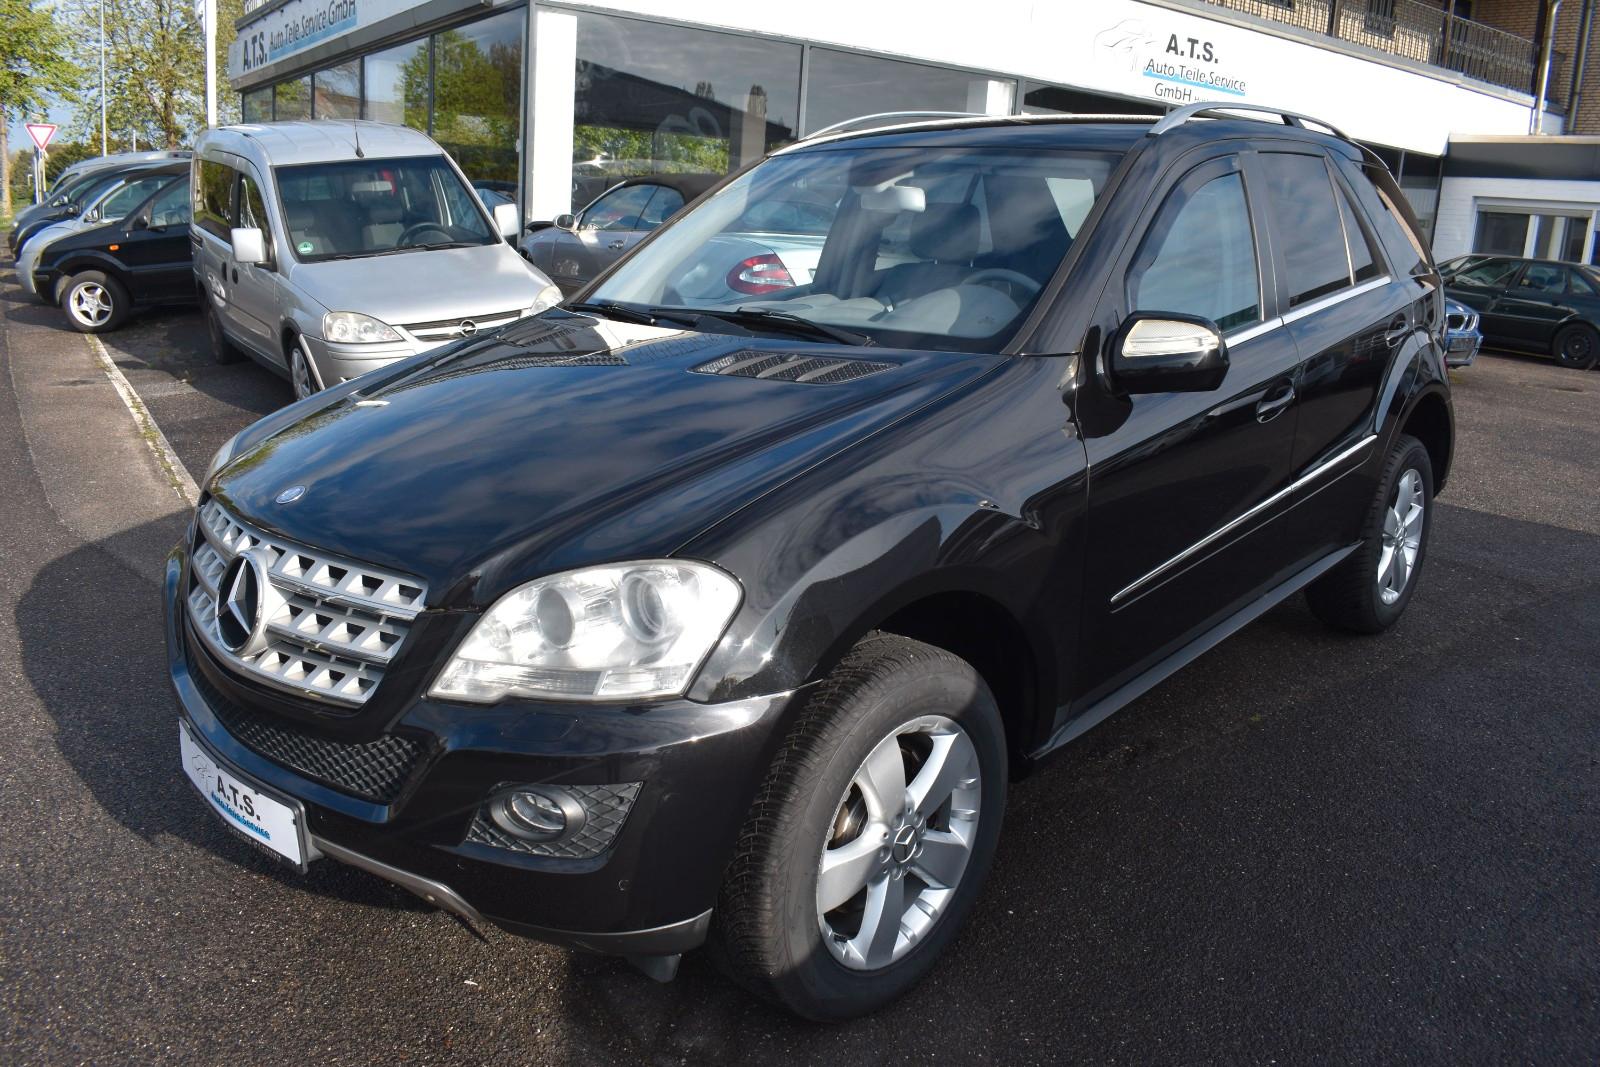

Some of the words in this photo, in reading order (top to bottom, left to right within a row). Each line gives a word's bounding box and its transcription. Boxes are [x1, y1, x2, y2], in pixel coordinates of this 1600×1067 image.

[243, 31, 267, 71] A.T.S.
[269, 31, 284, 51] Auto
[284, 20, 300, 43] Teile
[301, 8, 326, 38] Service
[328, 0, 356, 26] GmbH
[1165, 33, 1218, 64] A.T.S.
[1145, 58, 1175, 77] Auto
[1179, 64, 1206, 83] Teile
[1208, 71, 1246, 92] Service
[1154, 82, 1192, 102] GmbH
[217, 774, 261, 821] A.T.S.
[241, 815, 271, 841] Service
